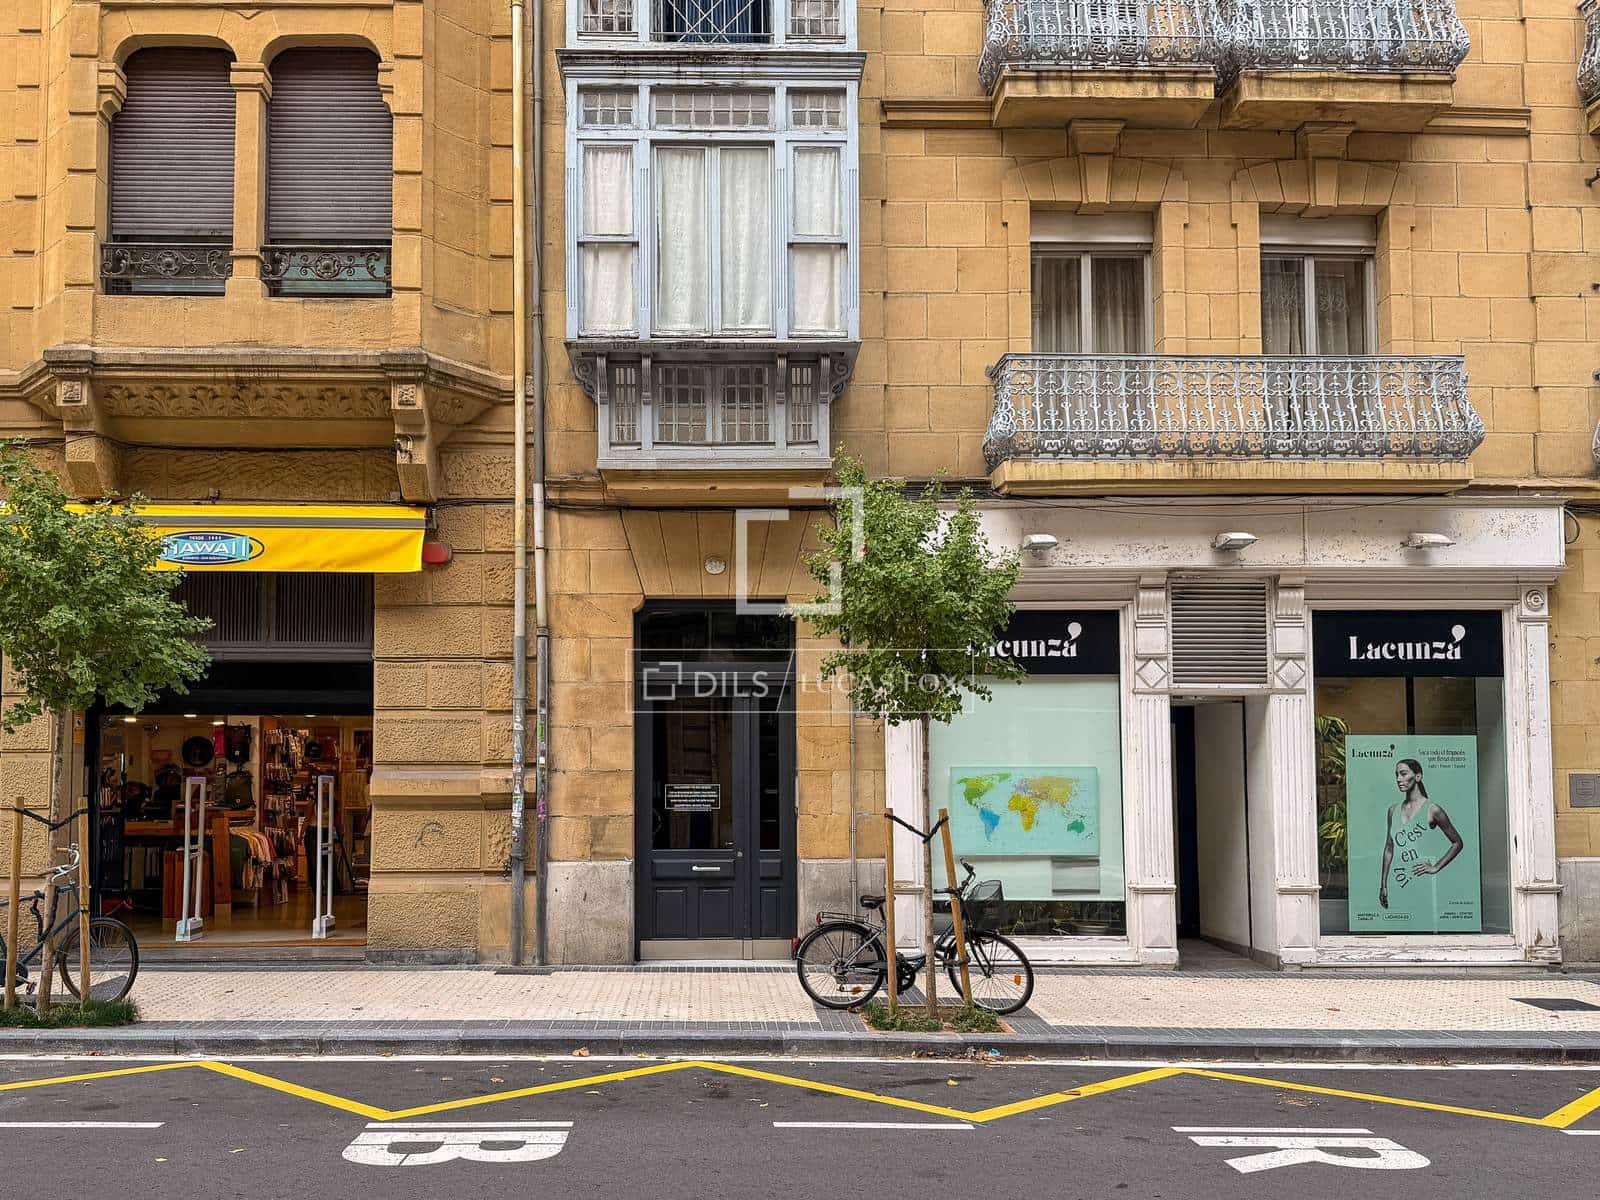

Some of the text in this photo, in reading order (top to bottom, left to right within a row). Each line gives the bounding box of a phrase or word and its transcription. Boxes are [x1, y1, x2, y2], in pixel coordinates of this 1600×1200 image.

[1395, 821, 1427, 847] C'est
[1401, 848, 1419, 863] en
[1393, 867, 1412, 889] toi
